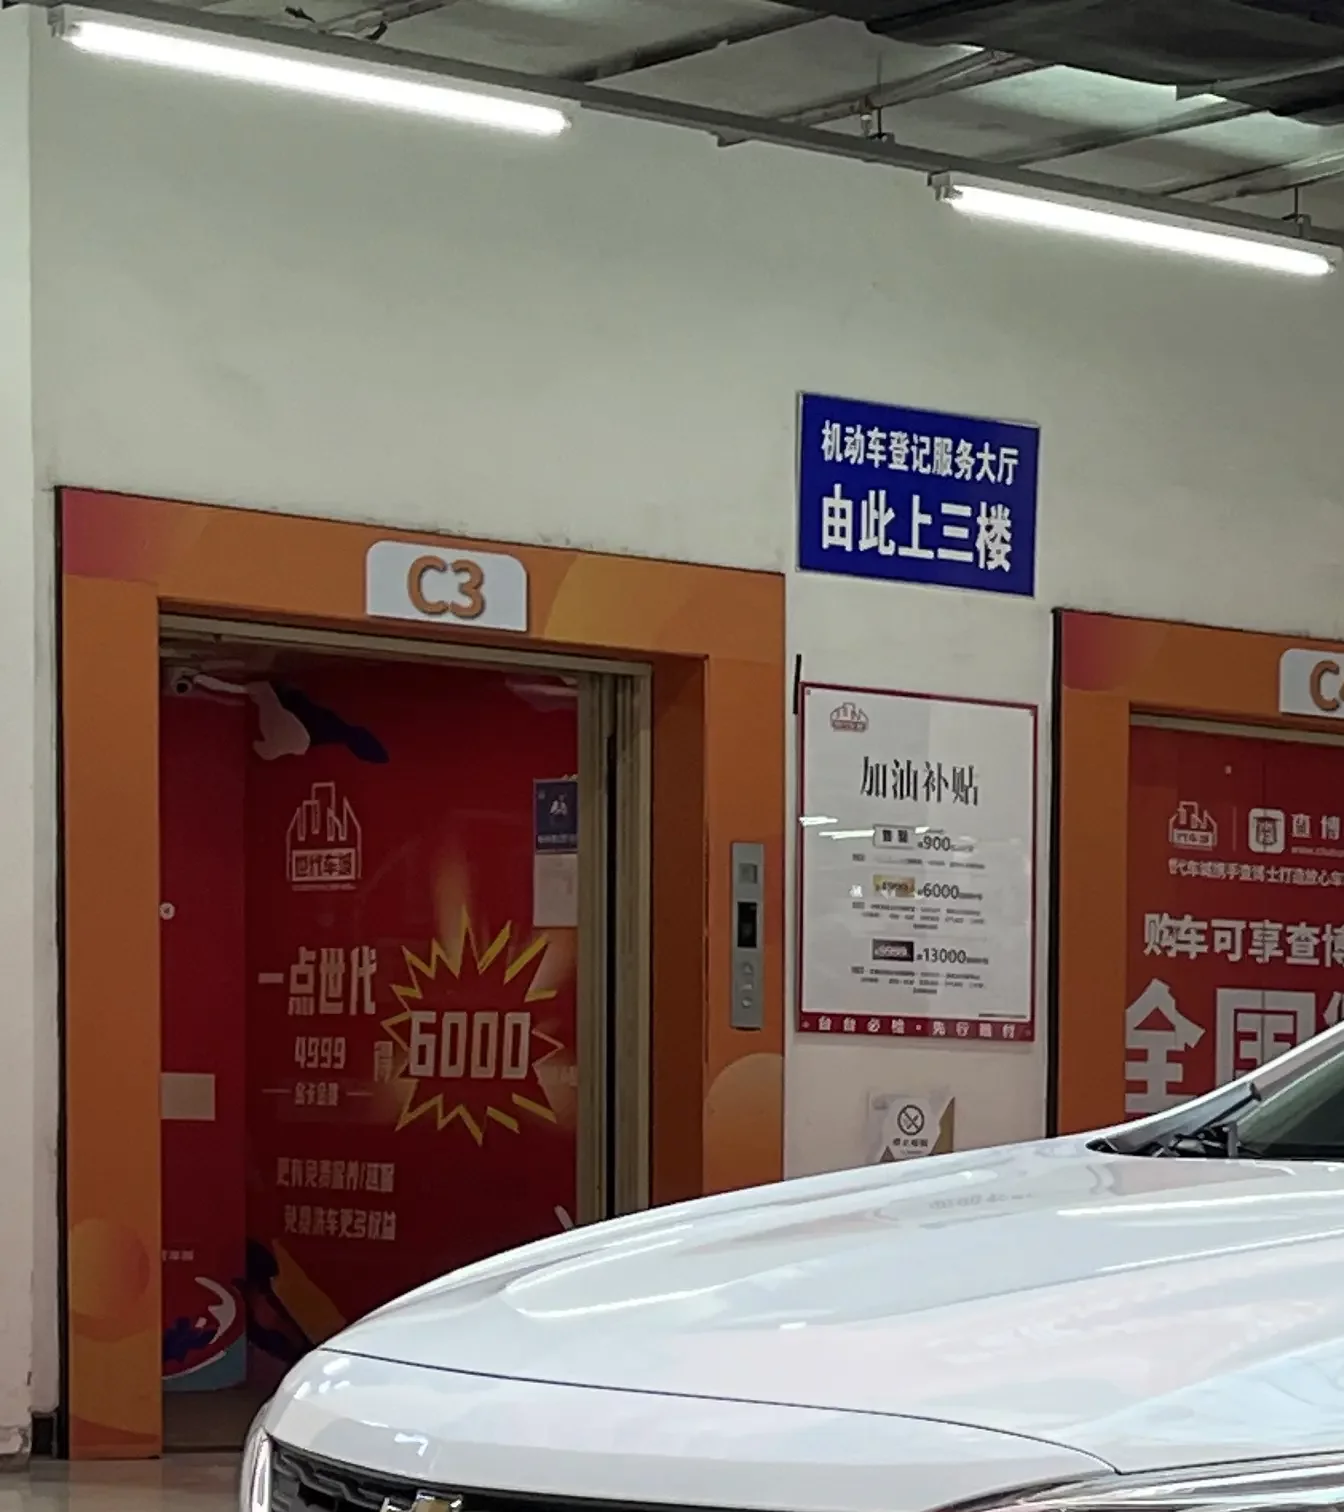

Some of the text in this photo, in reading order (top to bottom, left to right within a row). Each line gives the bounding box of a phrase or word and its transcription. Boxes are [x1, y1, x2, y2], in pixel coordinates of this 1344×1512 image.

[820, 418, 1020, 487] 机动车登记服务大厅
[821, 483, 1013, 573] 由此上三楼
[405, 554, 487, 620] C3
[859, 754, 980, 807] 加油补贴
[257, 944, 379, 1016] 一点世代
[293, 1035, 347, 1071] 4999
[408, 1010, 532, 1080] 6000
